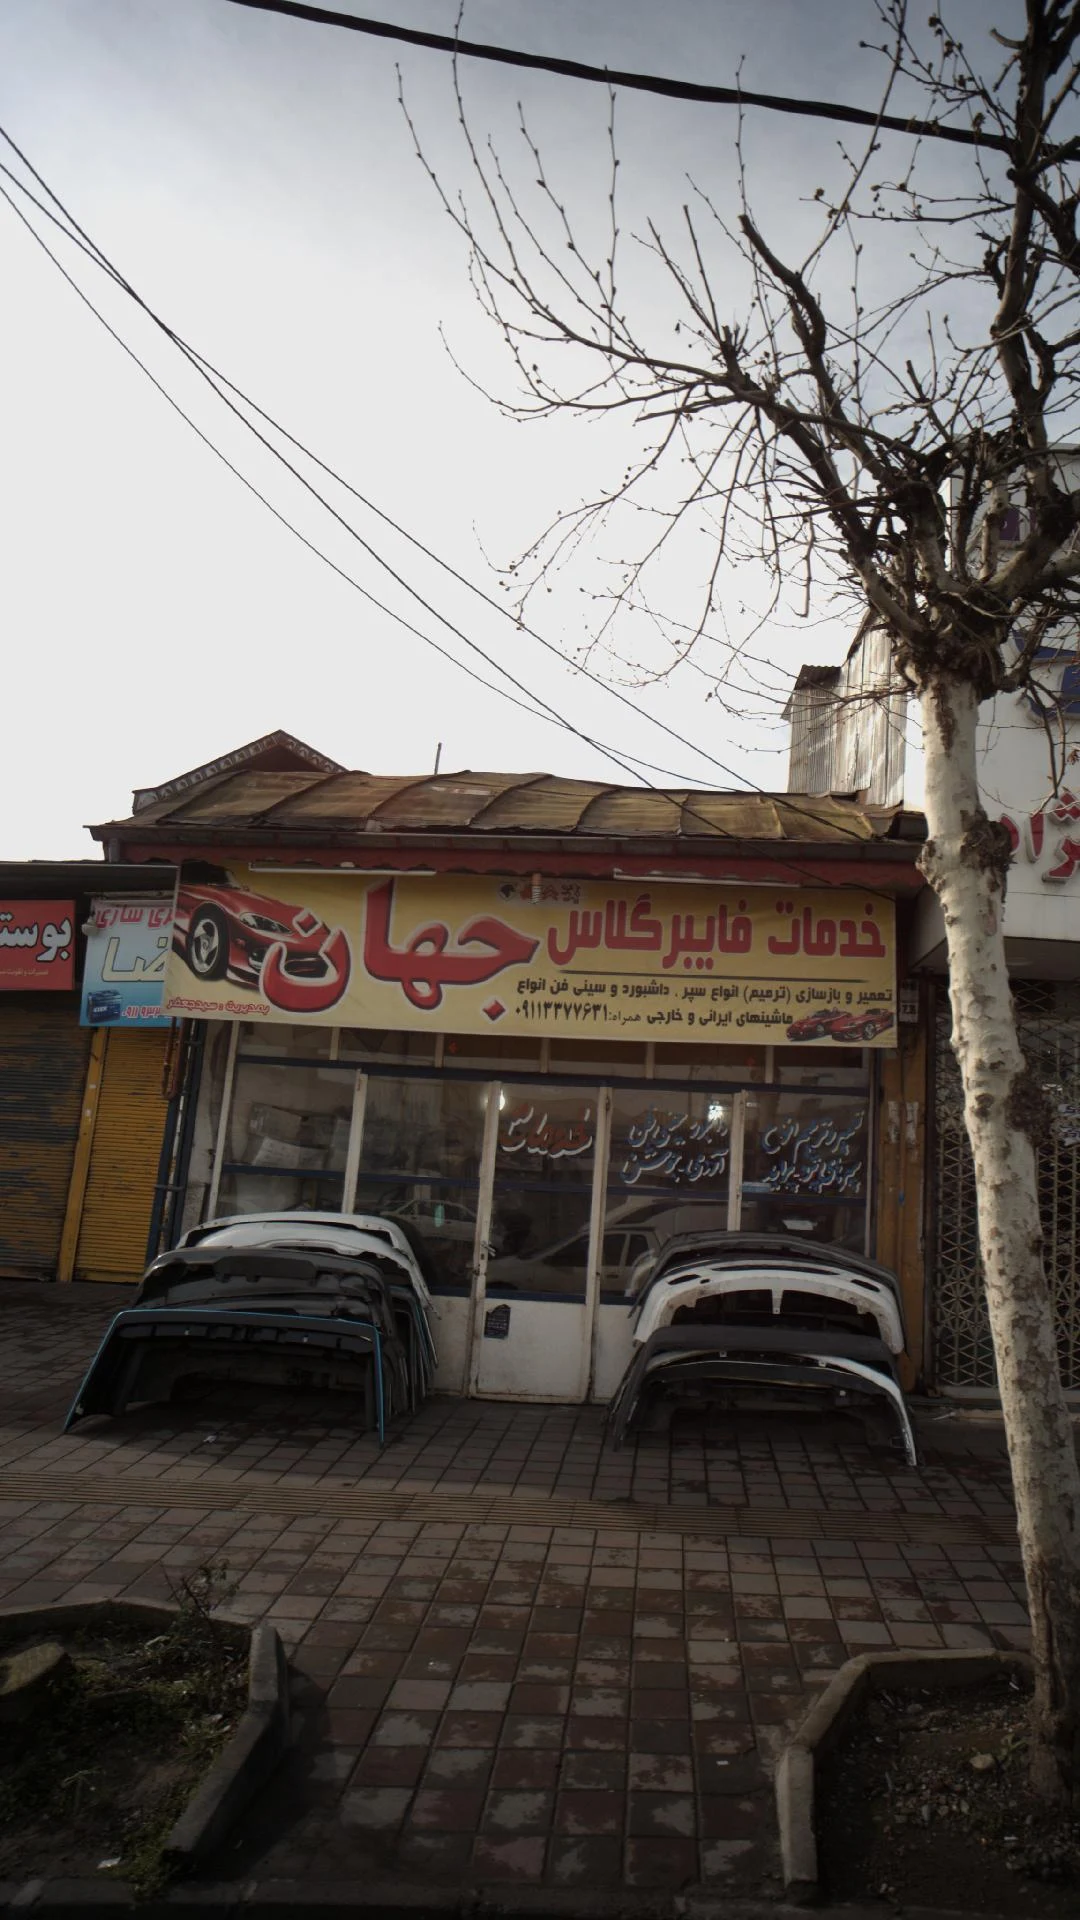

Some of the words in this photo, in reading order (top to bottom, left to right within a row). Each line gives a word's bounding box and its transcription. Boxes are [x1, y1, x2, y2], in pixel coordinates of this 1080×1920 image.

[0, 911, 72, 962] بوست
[547, 894, 753, 969] فایبرگلاس
[767, 902, 886, 958] خدمات
[260, 874, 539, 1021] جهان
[516, 977, 547, 995] انواع
[549, 978, 570, 997] فن
[572, 979, 607, 998] سینی
[609, 982, 619, 998] و
[622, 979, 670, 999] داشبورد
[680, 985, 707, 1004] سپر
[711, 984, 740, 1002] انواع
[743, 984, 792, 1006] (ترمیم)
[795, 986, 842, 1004] بازسازی
[845, 991, 854, 1005] و
[856, 989, 893, 1005] تعمیر
[646, 1008, 684, 1026] خارجی
[687, 1010, 697, 1026] و
[698, 1008, 733, 1028] ایرانی
[735, 1008, 794, 1029] ماشینهای
